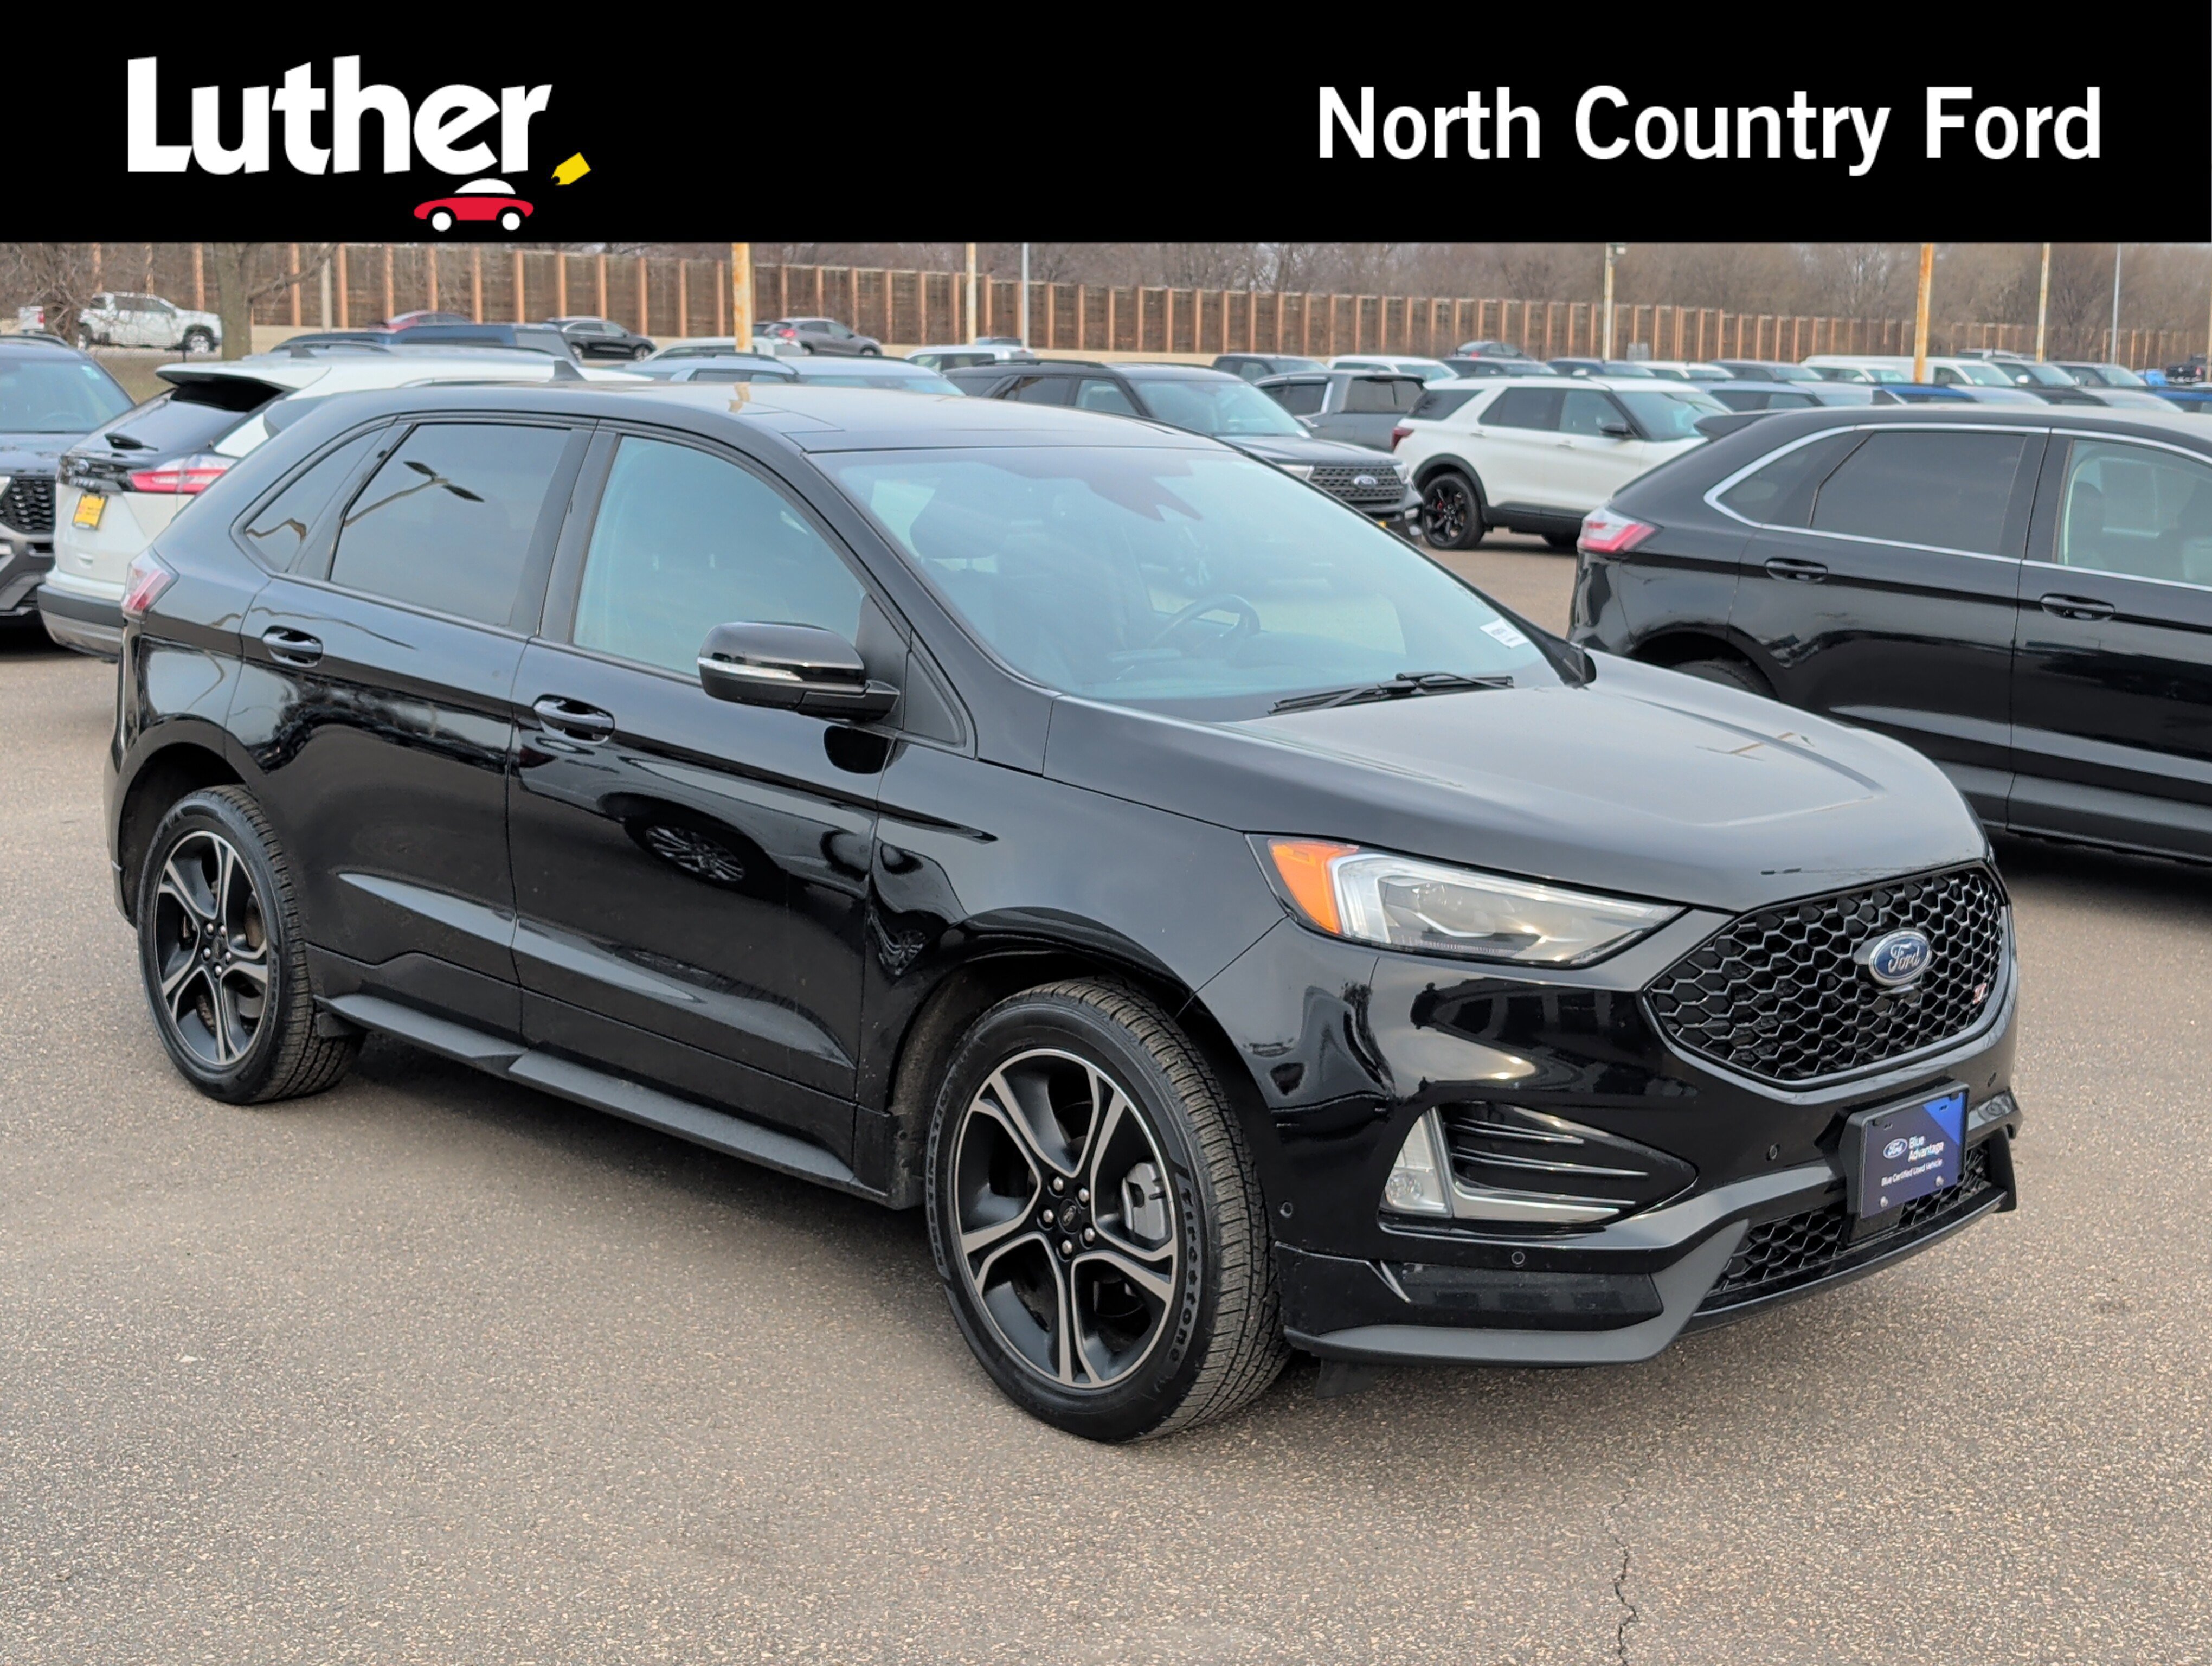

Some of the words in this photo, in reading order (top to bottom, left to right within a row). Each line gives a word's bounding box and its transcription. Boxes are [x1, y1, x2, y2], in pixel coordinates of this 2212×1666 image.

[1888, 942, 1920, 973] Ford
[1908, 1141, 1944, 1162] Advantage
[1909, 1136, 1925, 1149] Blue
[1169, 1187, 1198, 1363] Firestone
